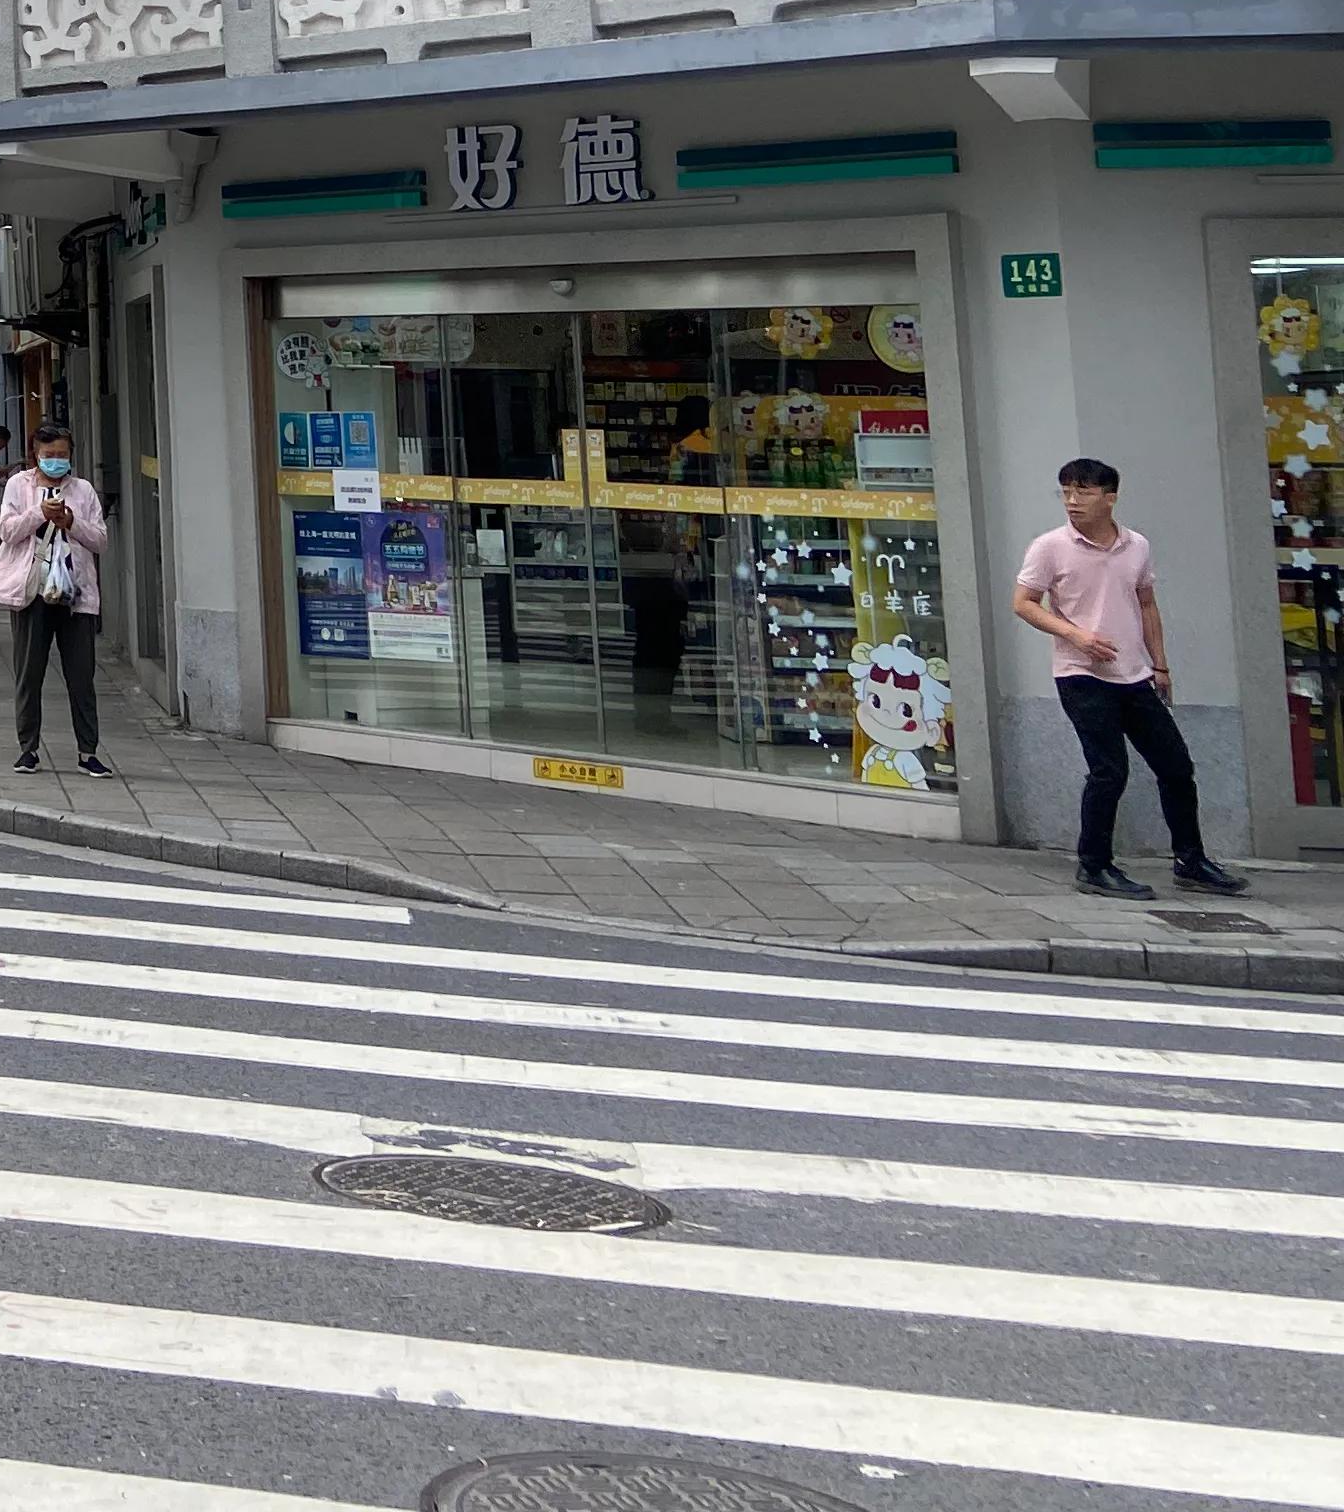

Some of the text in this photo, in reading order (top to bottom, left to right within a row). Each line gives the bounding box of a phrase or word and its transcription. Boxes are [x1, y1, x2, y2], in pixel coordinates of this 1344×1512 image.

[443, 115, 642, 211] 好德
[1010, 259, 1052, 282] 143
[859, 589, 932, 616] 白羊座
